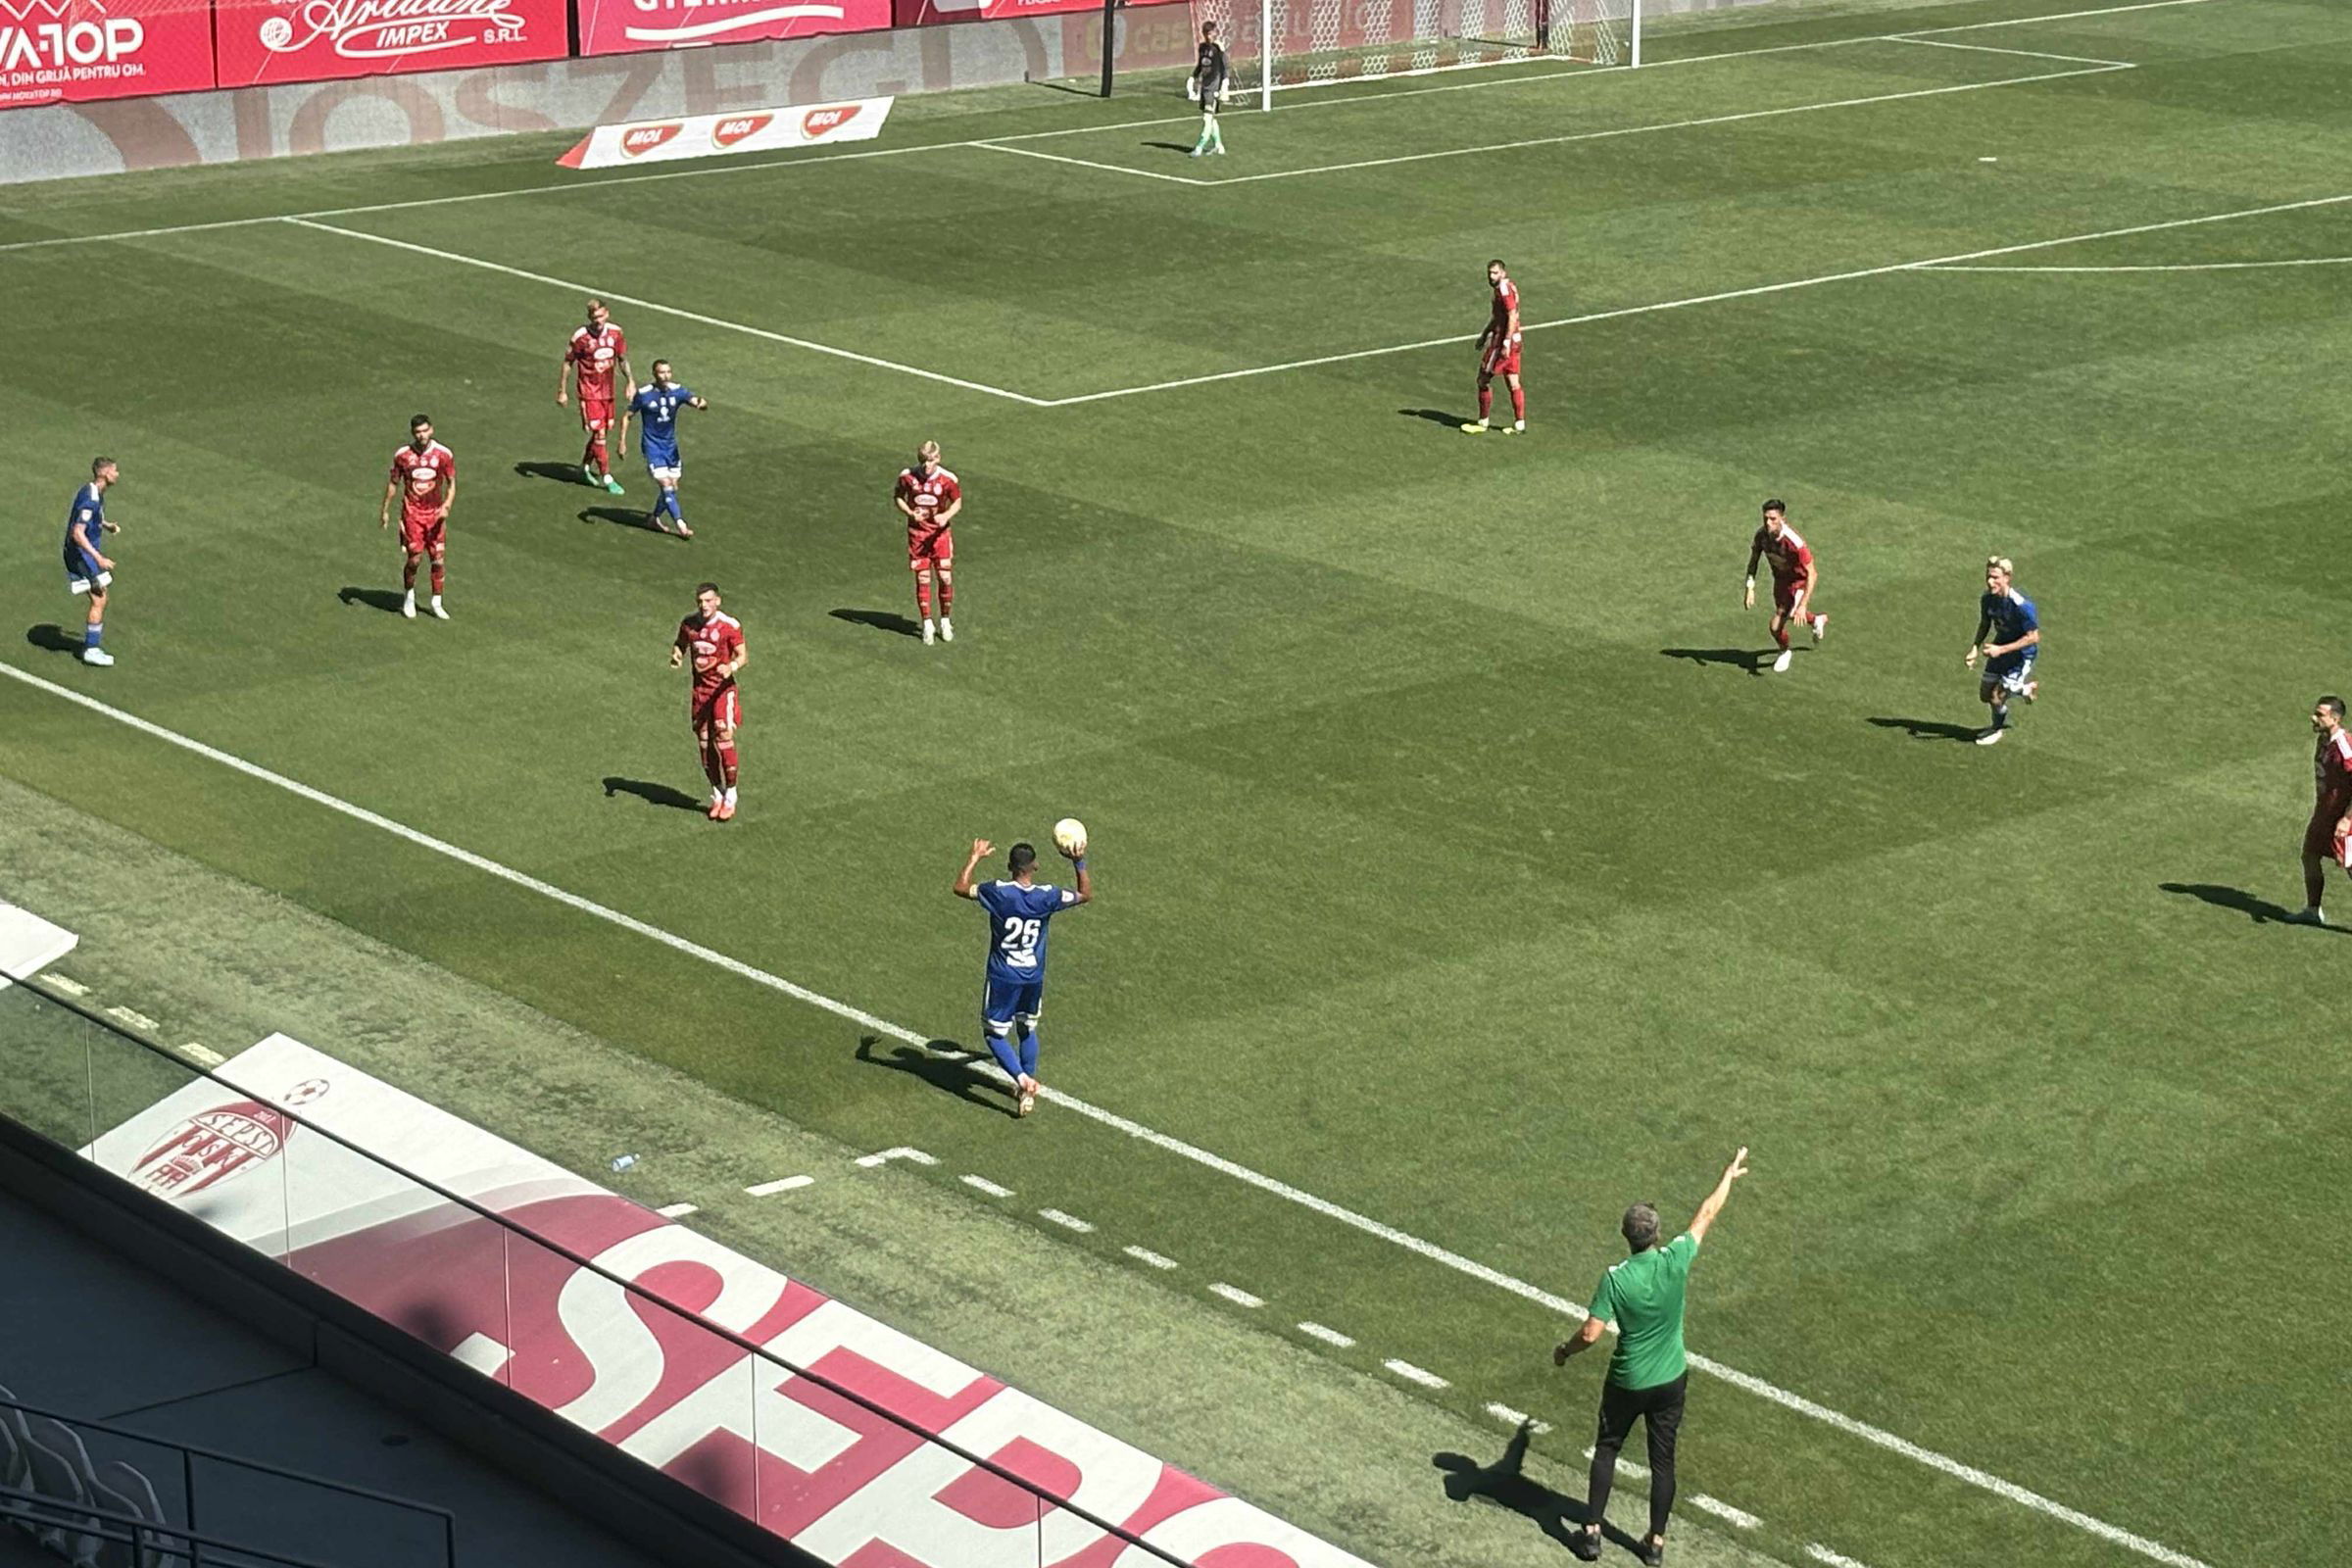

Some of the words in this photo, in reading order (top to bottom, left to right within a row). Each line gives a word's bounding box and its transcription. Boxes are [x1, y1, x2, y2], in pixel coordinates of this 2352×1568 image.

[376, 22, 449, 47] IMPEX
[12, 72, 34, 86] DIN
[74, 64, 120, 80] PENTRU
[718, 119, 754, 136] MOL
[808, 110, 842, 126] MOL
[626, 128, 662, 146] MOL
[1001, 916, 1042, 950] 26
[203, 1113, 273, 1154] SEPSI
